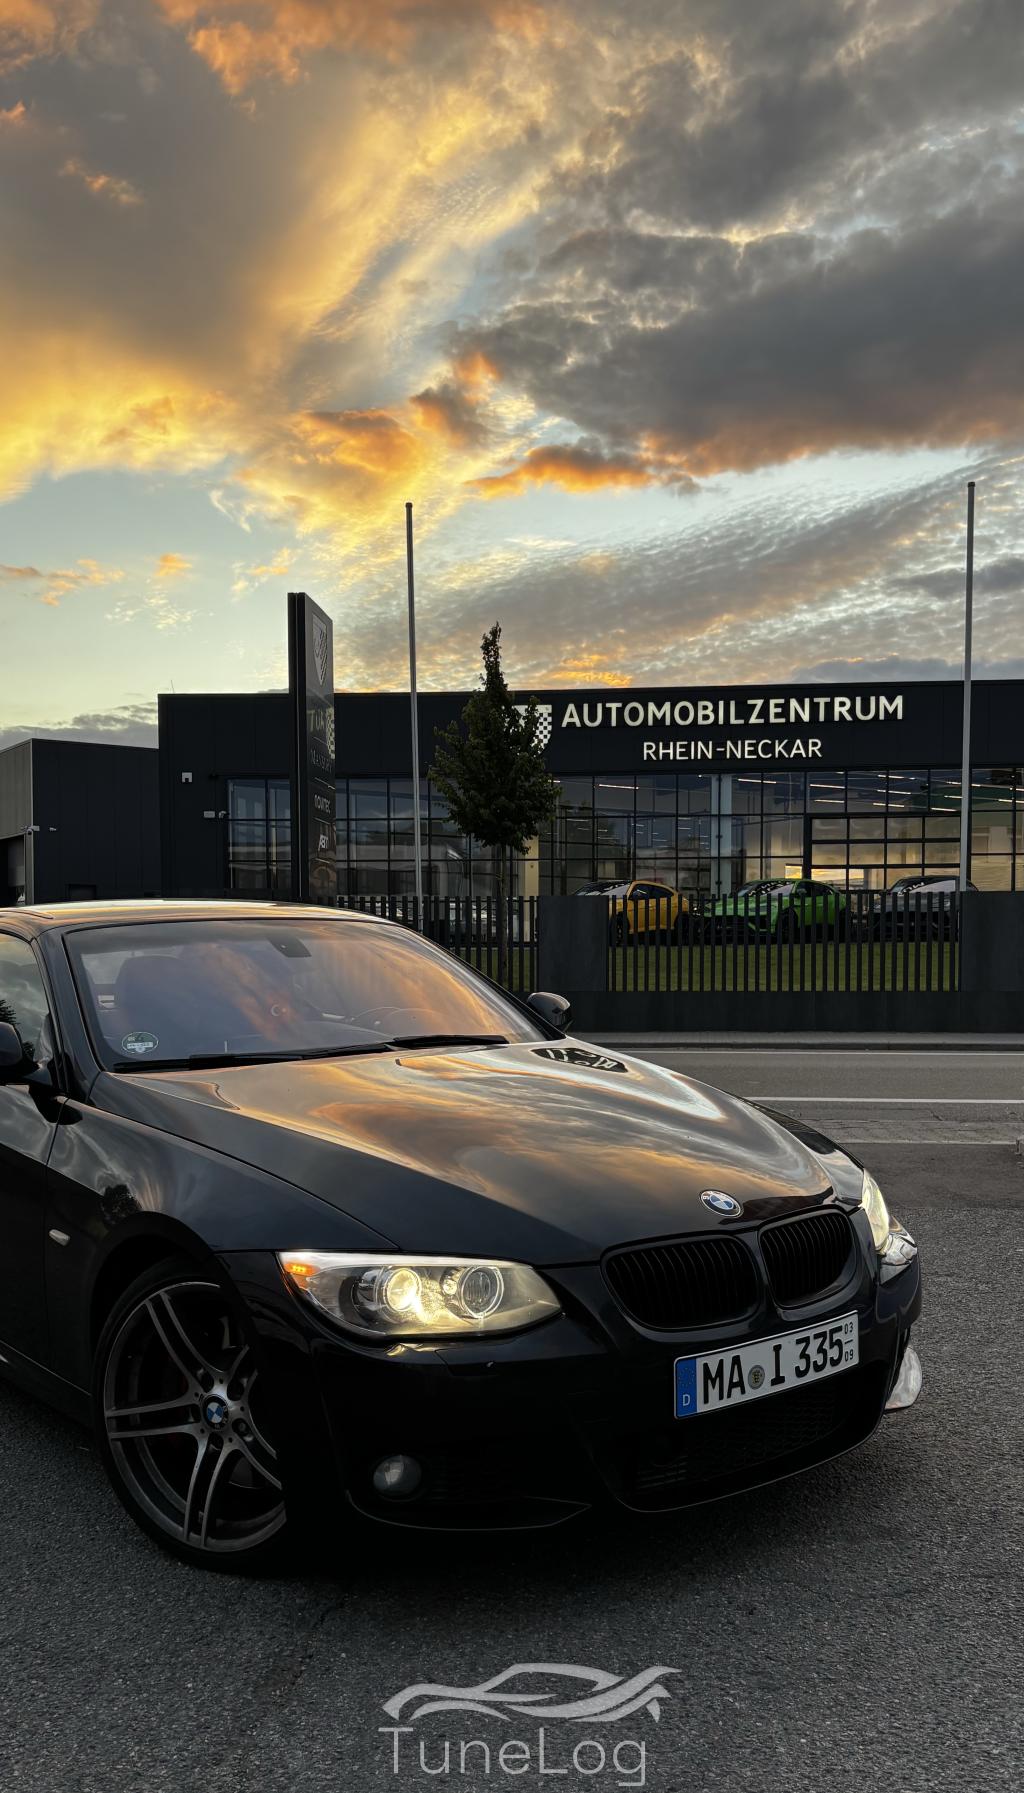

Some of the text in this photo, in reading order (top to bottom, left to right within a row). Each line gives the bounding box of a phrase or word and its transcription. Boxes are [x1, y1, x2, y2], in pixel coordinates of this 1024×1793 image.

[561, 695, 903, 728] AUTOMOBILZENTRUM
[643, 738, 822, 761] RHEIN-NECKAR
[844, 1321, 854, 1335] 03
[844, 1349, 854, 1362] 09
[702, 1325, 843, 1405] MA I 335
[682, 1394, 691, 1406] D
